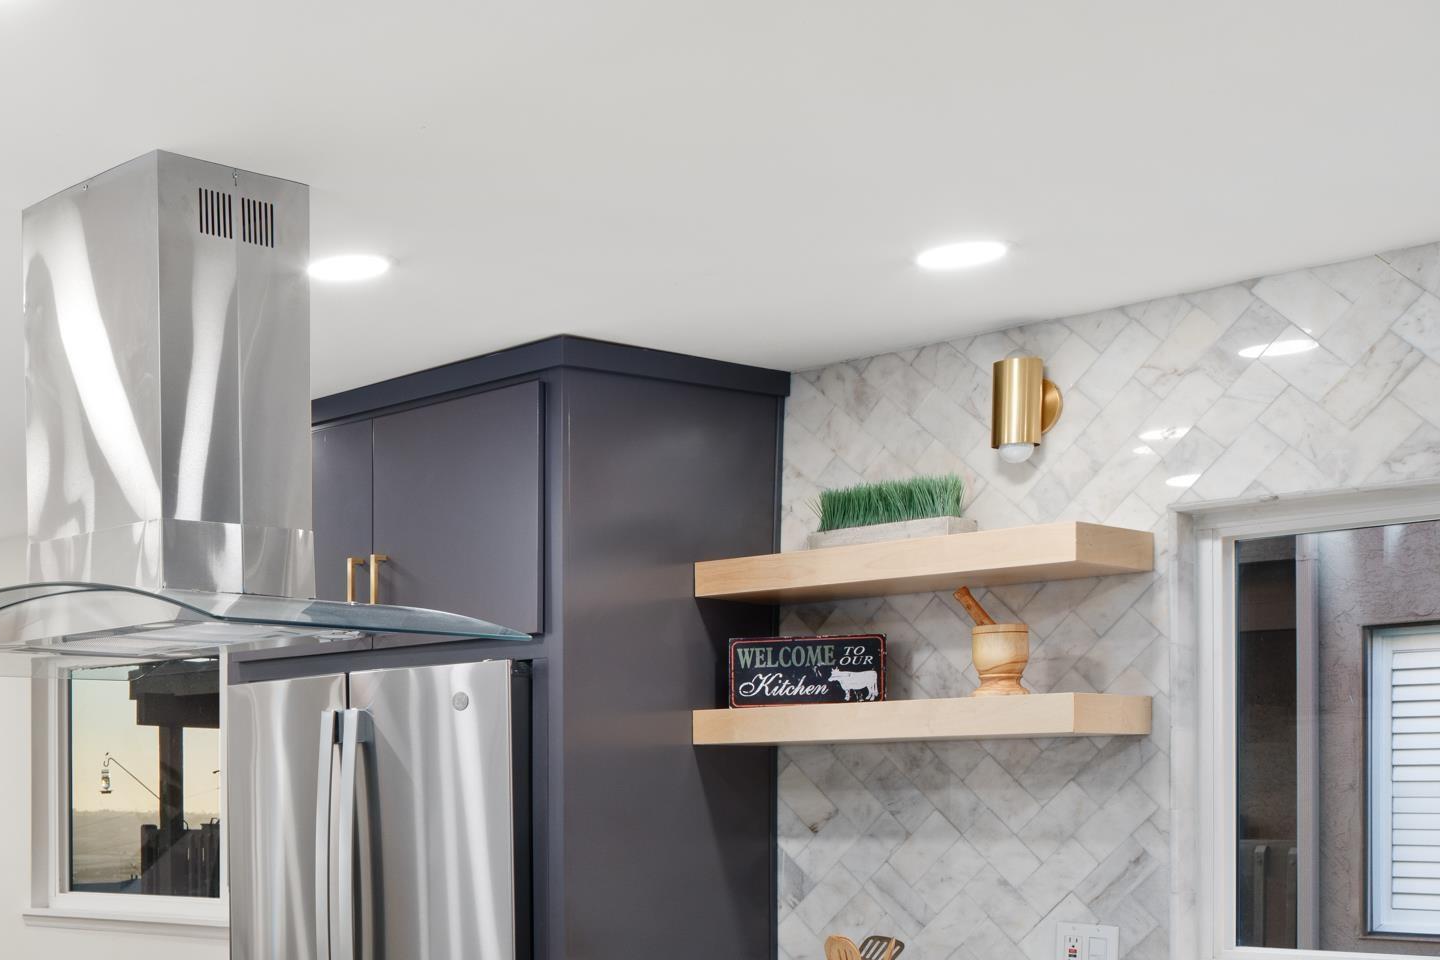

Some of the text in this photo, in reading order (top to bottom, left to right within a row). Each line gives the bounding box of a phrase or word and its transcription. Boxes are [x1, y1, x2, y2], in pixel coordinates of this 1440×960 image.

[737, 645, 837, 669] WELCOME
[844, 646, 866, 655] TO
[839, 655, 873, 666] OUR
[739, 673, 829, 697] Kitchen
